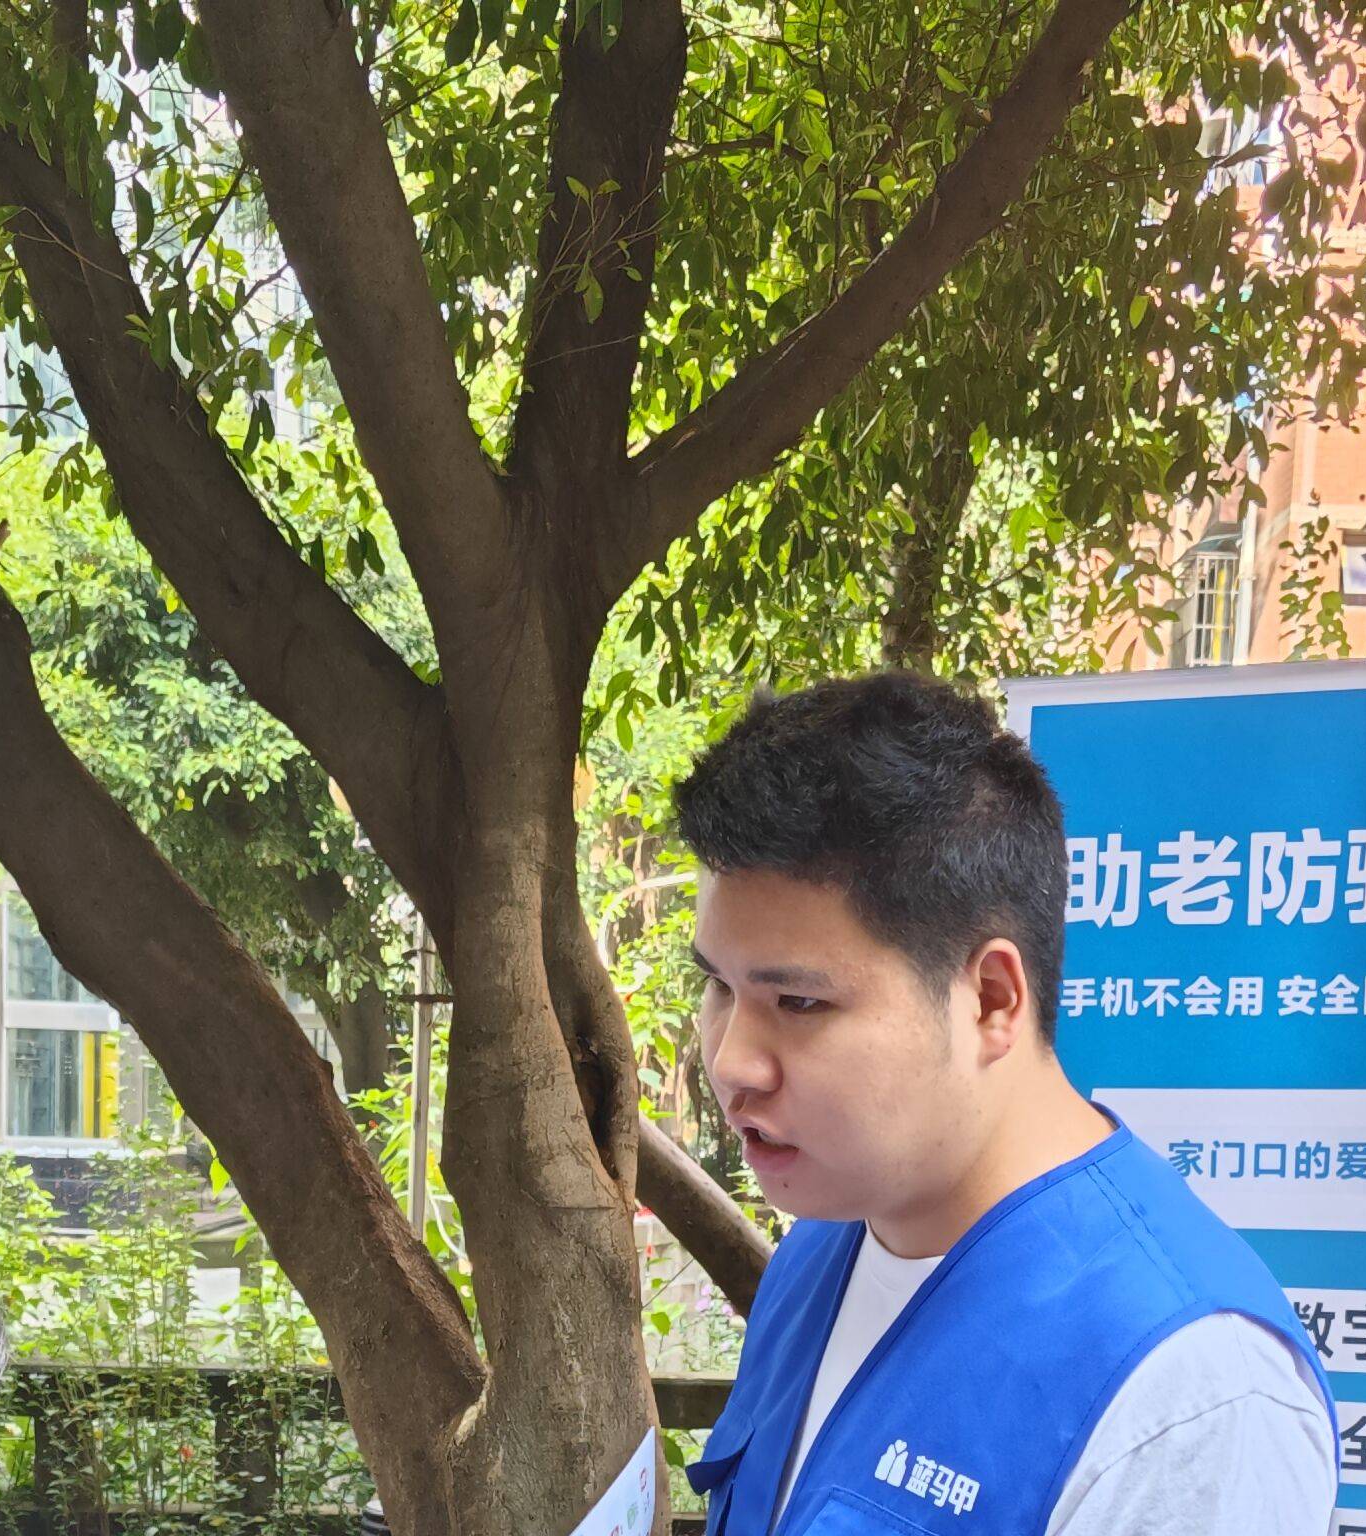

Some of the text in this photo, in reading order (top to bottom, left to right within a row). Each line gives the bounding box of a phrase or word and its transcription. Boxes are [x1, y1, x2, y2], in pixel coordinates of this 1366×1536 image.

[1060, 975, 1264, 1018] 手机不会用
[905, 1455, 981, 1516] 蓝马甲
